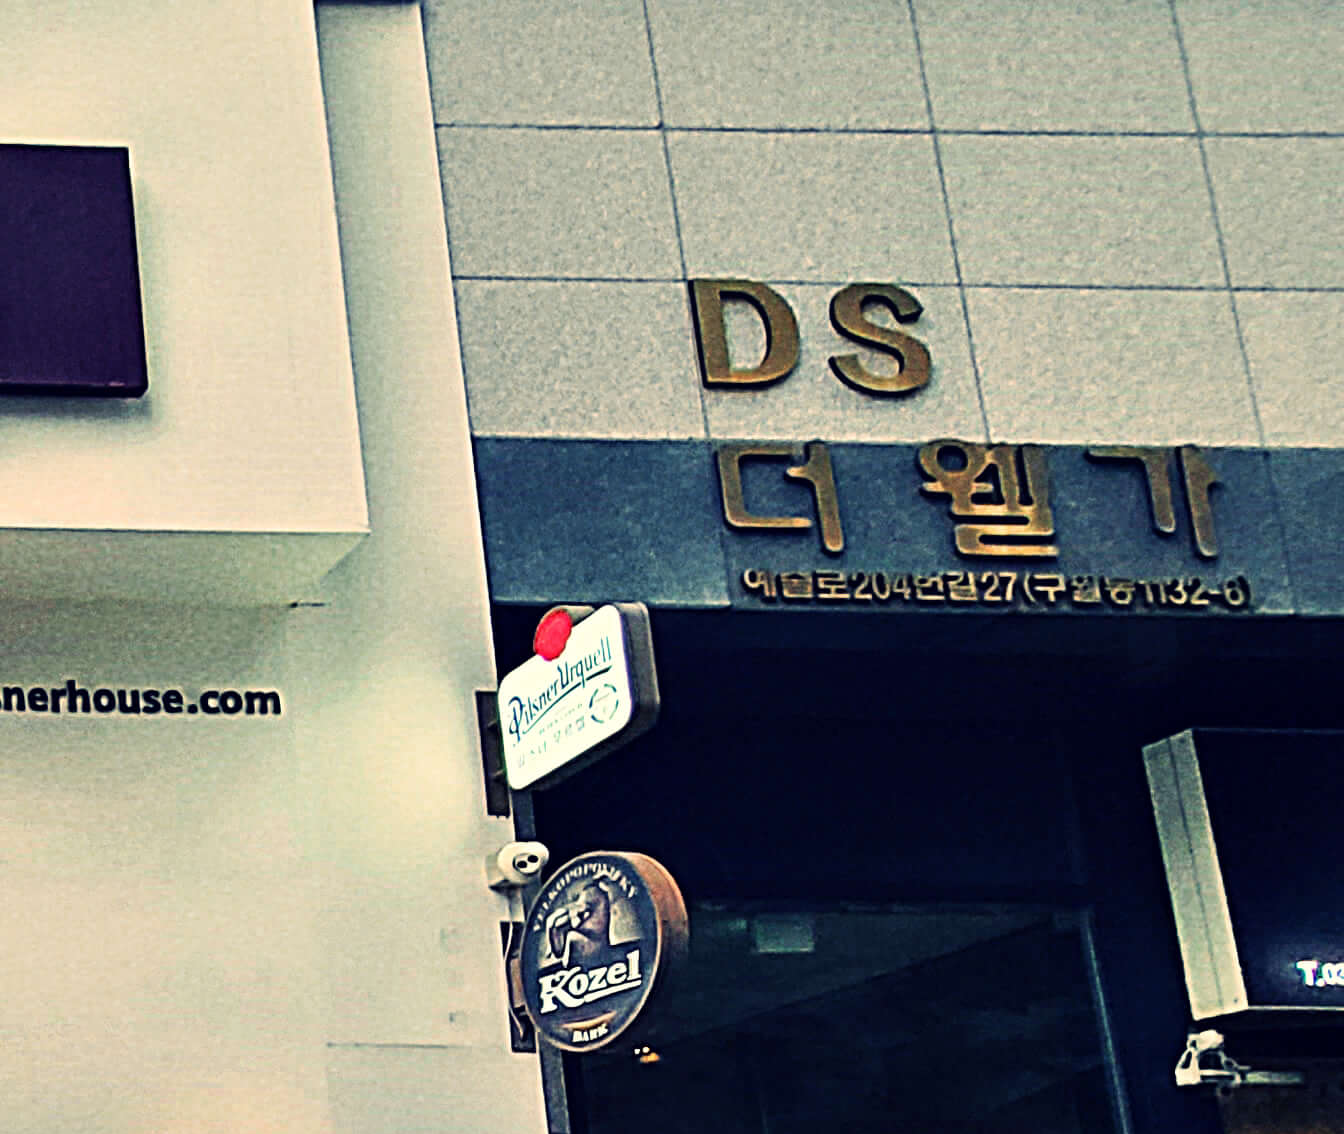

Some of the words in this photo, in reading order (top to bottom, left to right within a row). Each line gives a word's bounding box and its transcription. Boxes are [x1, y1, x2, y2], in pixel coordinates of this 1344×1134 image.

[508, 679, 559, 742] Pilsner
[557, 636, 612, 688] Urquell
[539, 950, 642, 1014] Kozel
